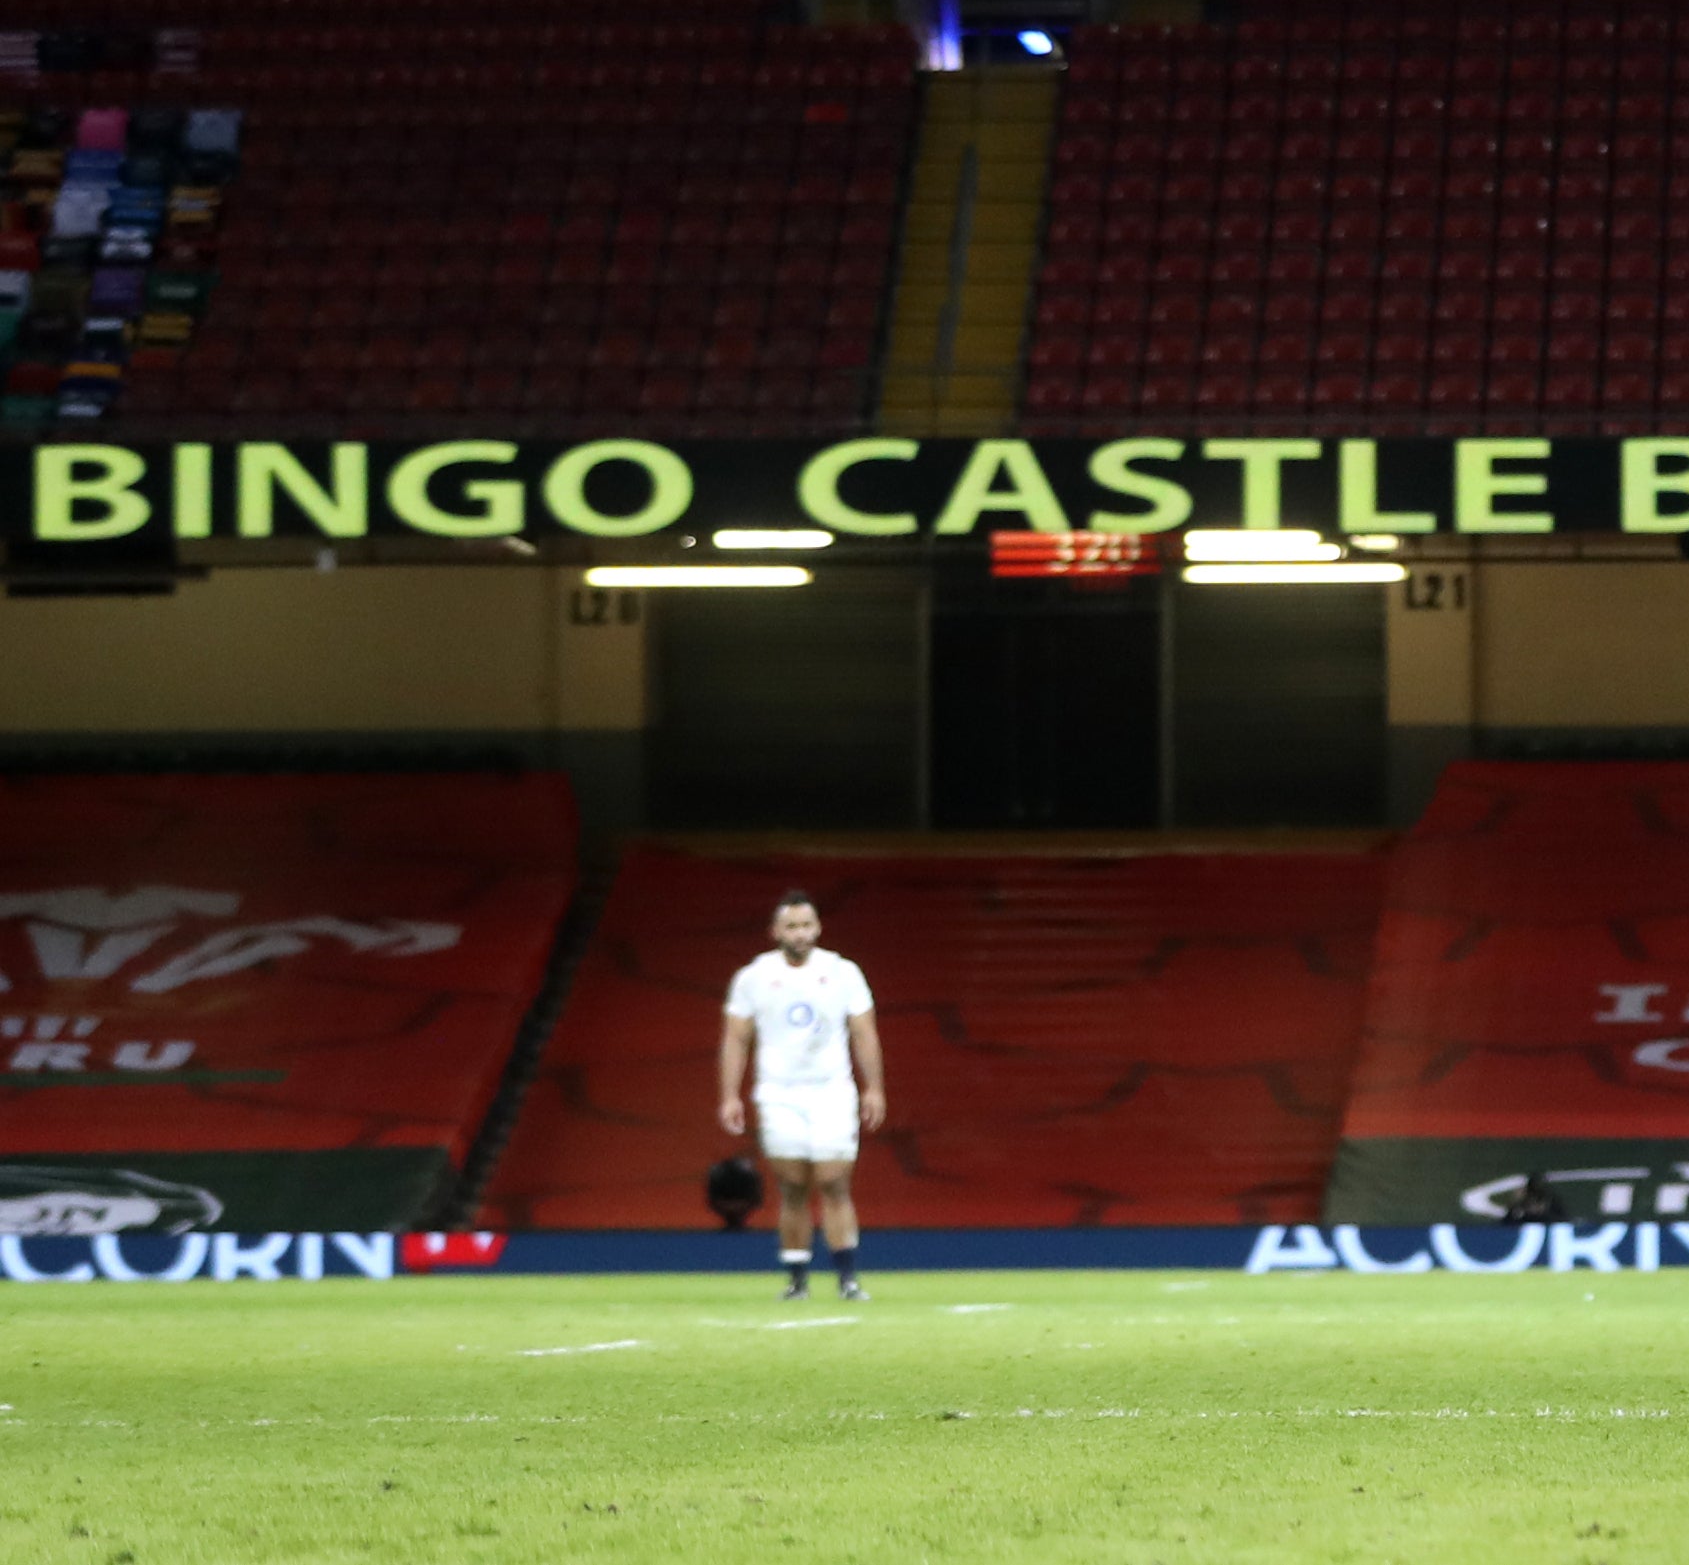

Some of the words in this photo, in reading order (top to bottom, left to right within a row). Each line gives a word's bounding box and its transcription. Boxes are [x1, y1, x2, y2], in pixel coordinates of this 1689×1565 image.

[36, 439, 692, 540] BINGO
[799, 438, 1553, 536] CASTLE
[1404, 573, 1465, 610] L21
